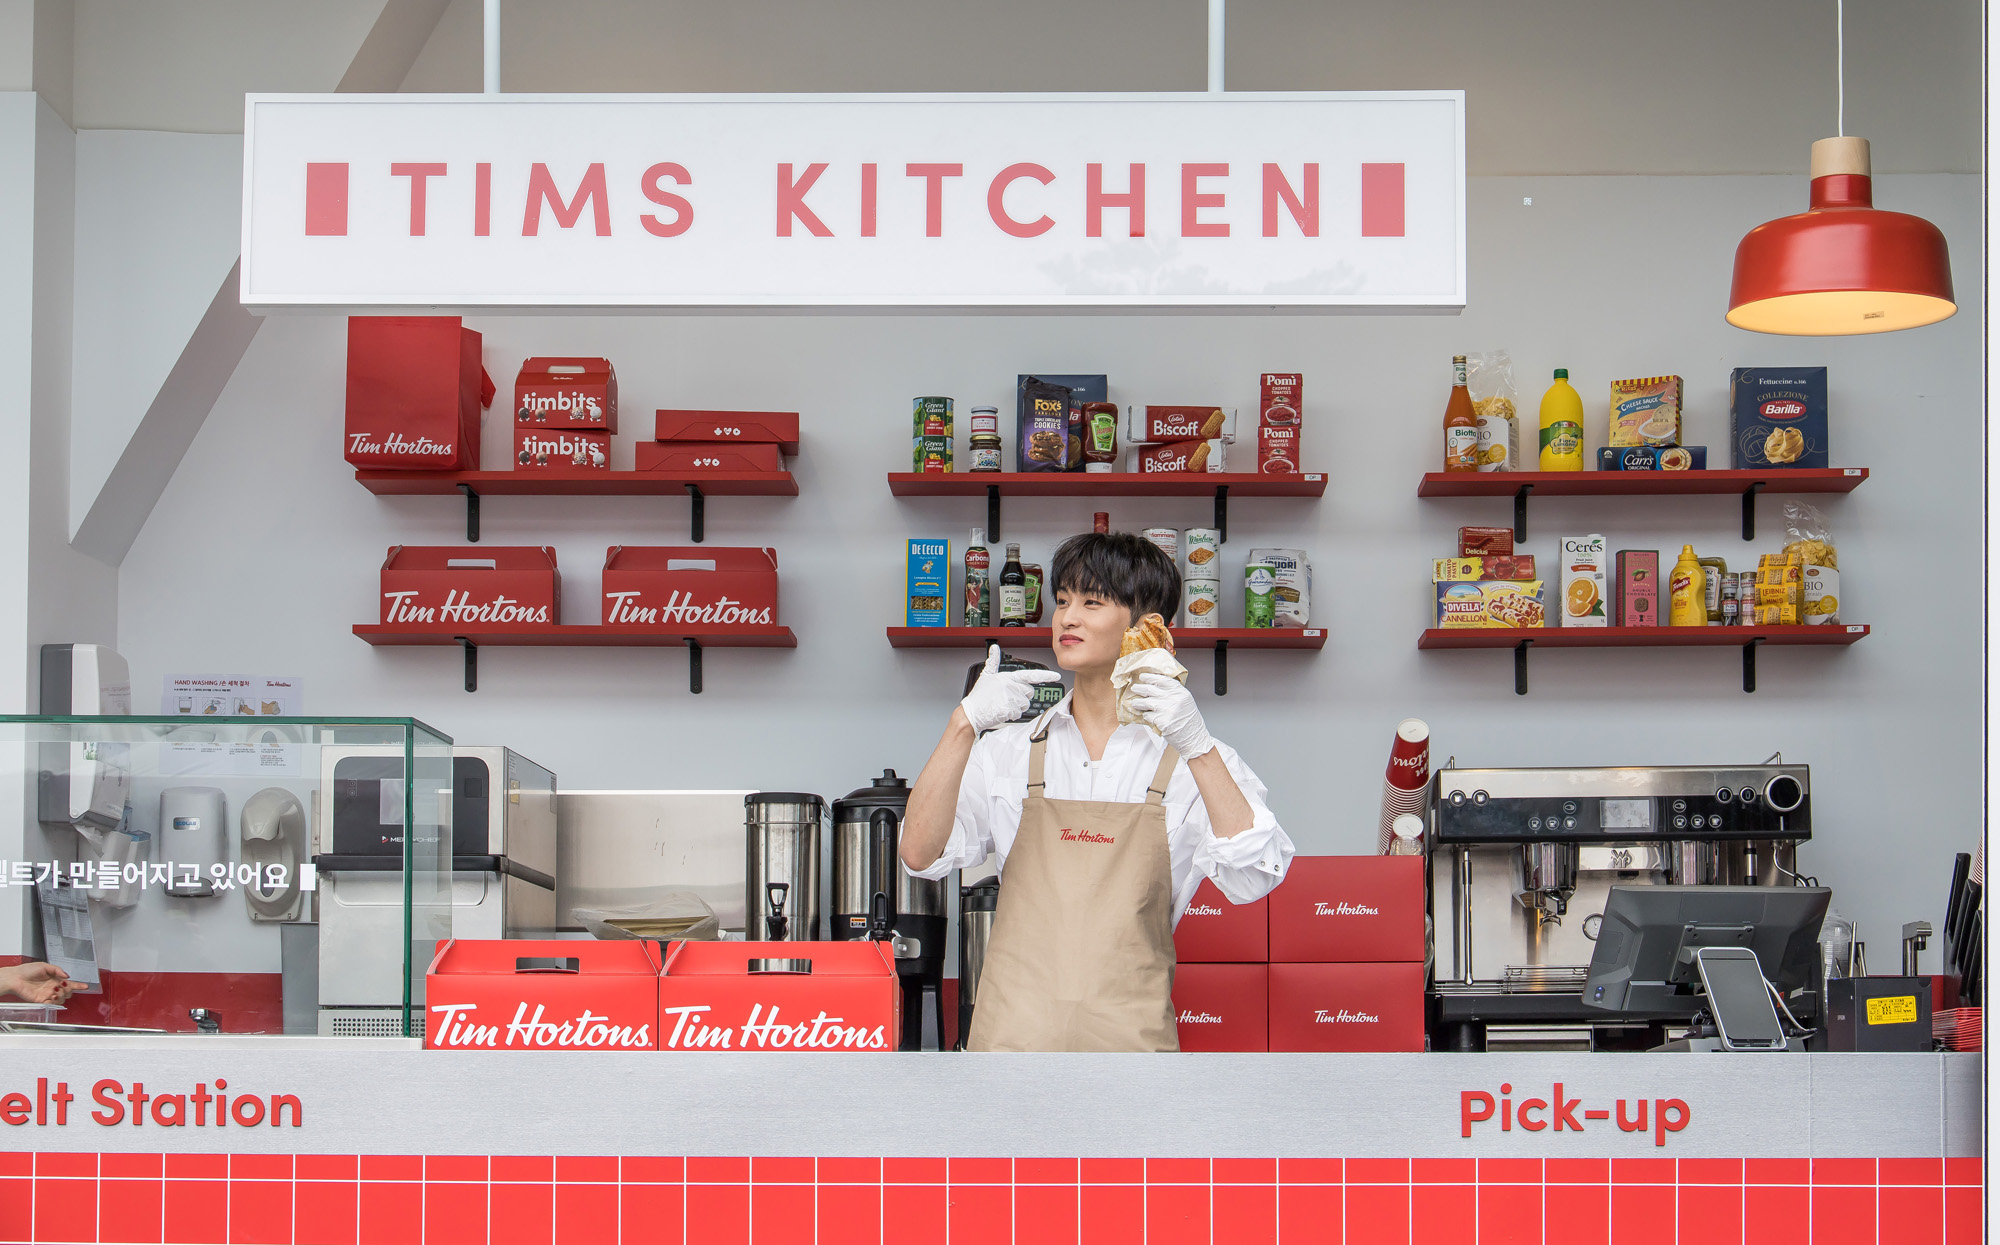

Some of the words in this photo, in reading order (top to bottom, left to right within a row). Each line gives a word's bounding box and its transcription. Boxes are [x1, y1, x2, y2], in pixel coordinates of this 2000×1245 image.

[391, 162, 695, 237] TIMS
[776, 162, 1320, 238] KITCHEN
[1266, 375, 1296, 386] Pomì
[522, 391, 596, 411] timbits
[1757, 391, 1809, 402] COLLEZIONE
[1620, 400, 1642, 412] CHEESE
[1642, 397, 1658, 405] SAUCE
[1765, 404, 1801, 414] Barilla
[1034, 421, 1061, 430] COOKIES
[1154, 420, 1198, 436] Biscoff
[1264, 427, 1294, 438] Pomì
[1455, 429, 1477, 437] Biotta
[1477, 431, 1491, 440] IO
[349, 433, 380, 455] Tim
[384, 432, 452, 455] Hortons
[522, 435, 599, 455] timbits
[925, 440, 944, 448] Green
[1145, 455, 1186, 472] Biscoff
[1624, 454, 1654, 465] Carr's
[911, 543, 921, 555] DE
[922, 543, 944, 555] CECCO
[1565, 540, 1603, 553] Ceres
[1763, 588, 1786, 596] LEIBNIZ
[1803, 581, 1824, 590] BIO
[384, 591, 434, 624] Tim
[440, 589, 548, 624] Hortons
[606, 591, 658, 624] Tim
[663, 590, 771, 625] Hortons
[1447, 603, 1480, 612] DIVELLA
[1440, 614, 1487, 623] CANNELLONI
[1060, 828, 1076, 842] Tim
[1077, 829, 1115, 844] Hortons
[70, 860, 202, 890] 만들어지고
[210, 861, 290, 891] 있어요
[1314, 902, 1334, 915] Tim
[1336, 901, 1379, 915] Hortons
[431, 1003, 499, 1047] Tim
[506, 1001, 650, 1047] Hortons
[1179, 1009, 1222, 1024] Hortons
[1314, 1010, 1335, 1023] Tim
[1336, 1009, 1379, 1024] Hortons
[664, 1004, 734, 1048] Tim
[740, 1002, 884, 1049] Hortons
[0, 1077, 74, 1126] elt
[91, 1078, 302, 1127] Station
[1460, 1082, 1691, 1146] Pick-up
